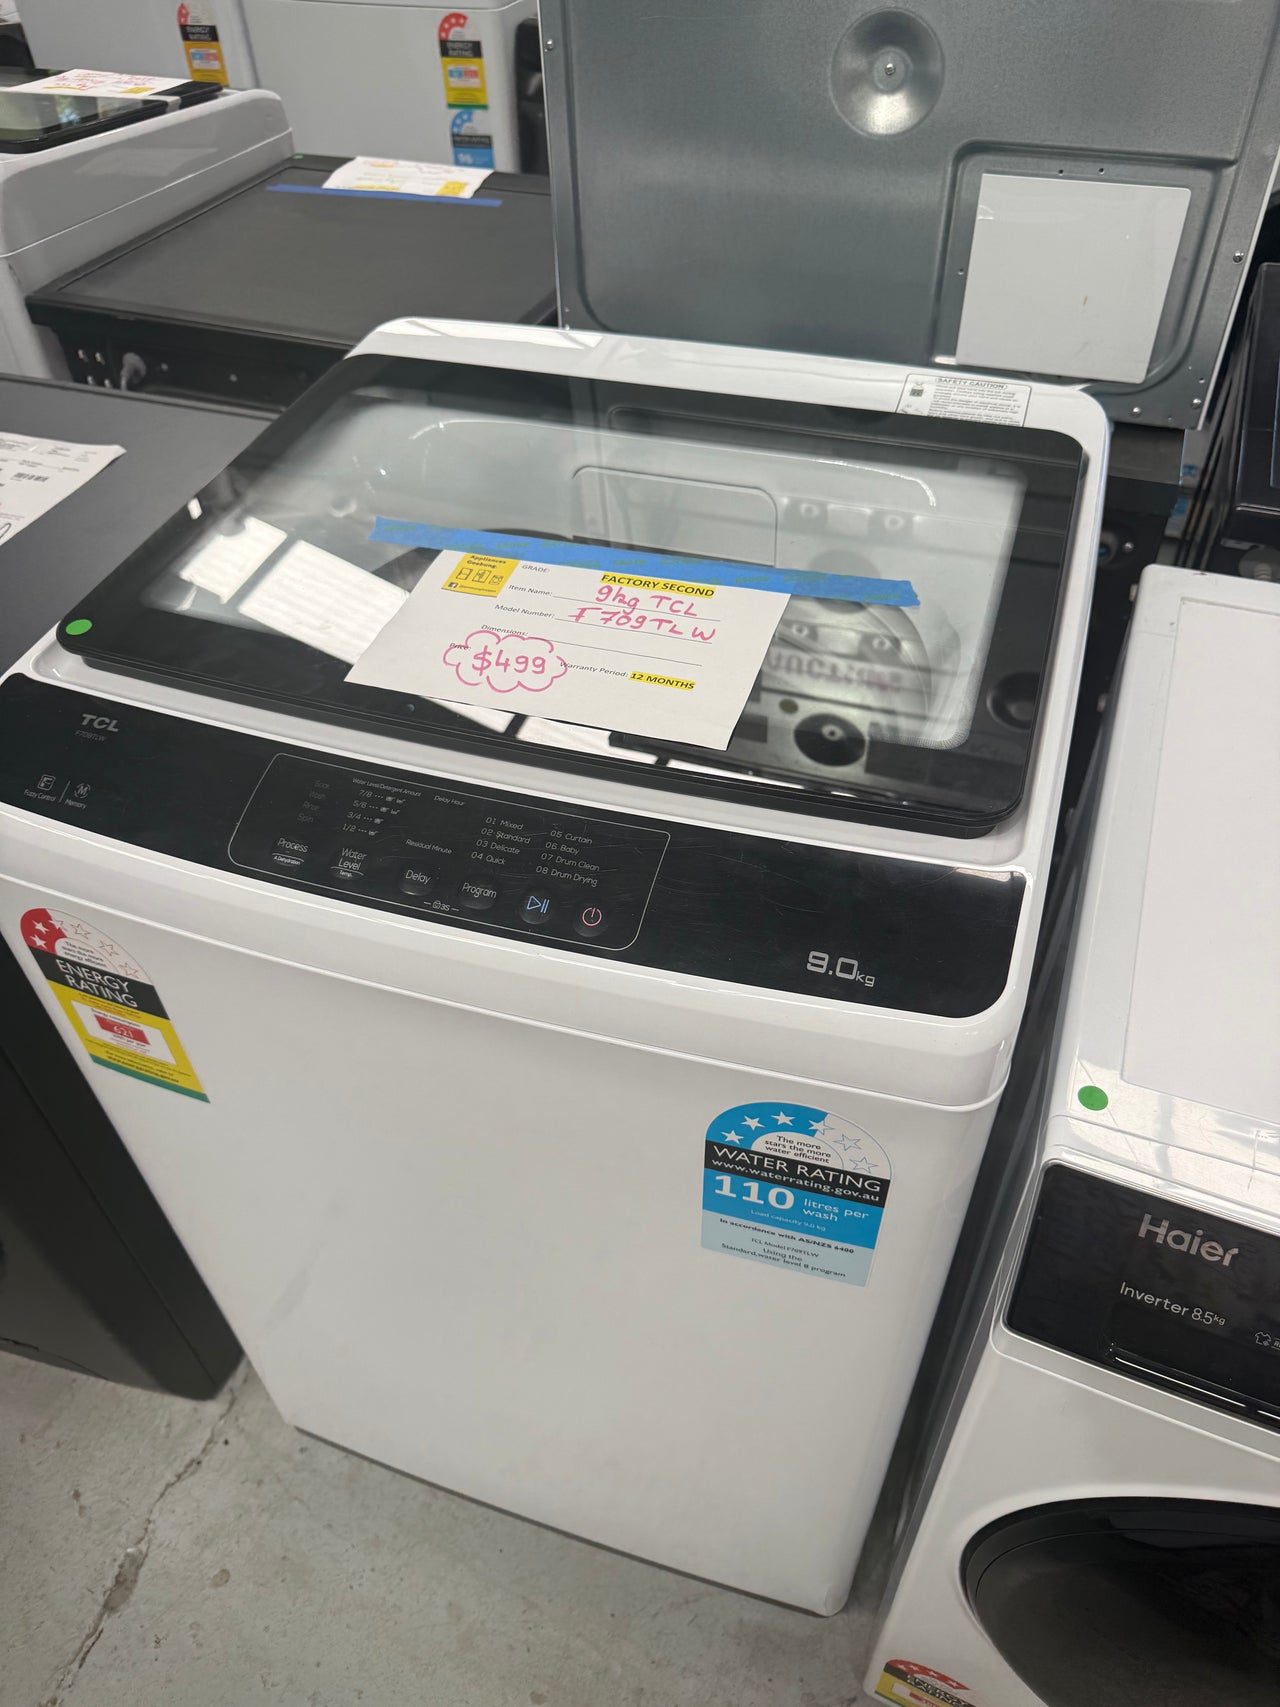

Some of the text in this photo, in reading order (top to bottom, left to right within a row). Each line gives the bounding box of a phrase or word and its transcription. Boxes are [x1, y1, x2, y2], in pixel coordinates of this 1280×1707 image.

[509, 584, 553, 597] Item Name:
[601, 574, 715, 597] FACTORY SECOND
[495, 604, 555, 619] Model Number:
[650, 595, 698, 617] TCL
[481, 624, 528, 637] Dimensions:
[449, 642, 472, 651] Price:
[472, 645, 546, 677] $499
[560, 662, 695, 690] Warranty Period: 12 MONTHS
[82, 714, 119, 732] TCL
[360, 789, 373, 798] 7/8
[347, 812, 362, 820] 3/4
[486, 817, 524, 830] 01 Mixed
[342, 824, 356, 832] 1/2
[481, 828, 531, 844] 02 Standard
[550, 830, 593, 845] 05 Curtain
[278, 838, 309, 854] Process
[406, 839, 452, 854] Residual Minute
[476, 840, 520, 855] 03 Delicate
[545, 842, 580, 856] 06 Baby
[342, 848, 367, 861] Water
[471, 852, 506, 865] 04 Quick
[541, 852, 601, 872] 07 Drum Clean
[338, 858, 362, 871] Level
[406, 870, 432, 885] Delay
[536, 866, 598, 888] 08 Drum Drying
[462, 882, 497, 899] Program
[56, 958, 129, 993] ENERGY
[66, 975, 138, 1008] RATING
[764, 1140, 832, 1158] stars the more
[776, 1136, 822, 1150] The more
[765, 1146, 830, 1164] water efficient
[714, 1146, 881, 1192] WATER RATING
[712, 1159, 880, 1202] www.waterrating.gov.au
[714, 1175, 869, 1220] 110 litres per
[750, 1210, 770, 1218] Load
[771, 1214, 802, 1226] capacity
[802, 1208, 838, 1222] wash
[730, 1220, 776, 1236] accordance
[778, 1232, 797, 1241] with
[798, 1237, 832, 1250] AS/NZS
[834, 1244, 855, 1254] 6400
[1138, 1213, 1239, 1266] Haier
[762, 1248, 803, 1262] Using the
[783, 1258, 802, 1268] level
[811, 1266, 846, 1278] program
[1120, 1282, 1190, 1316] Inverter
